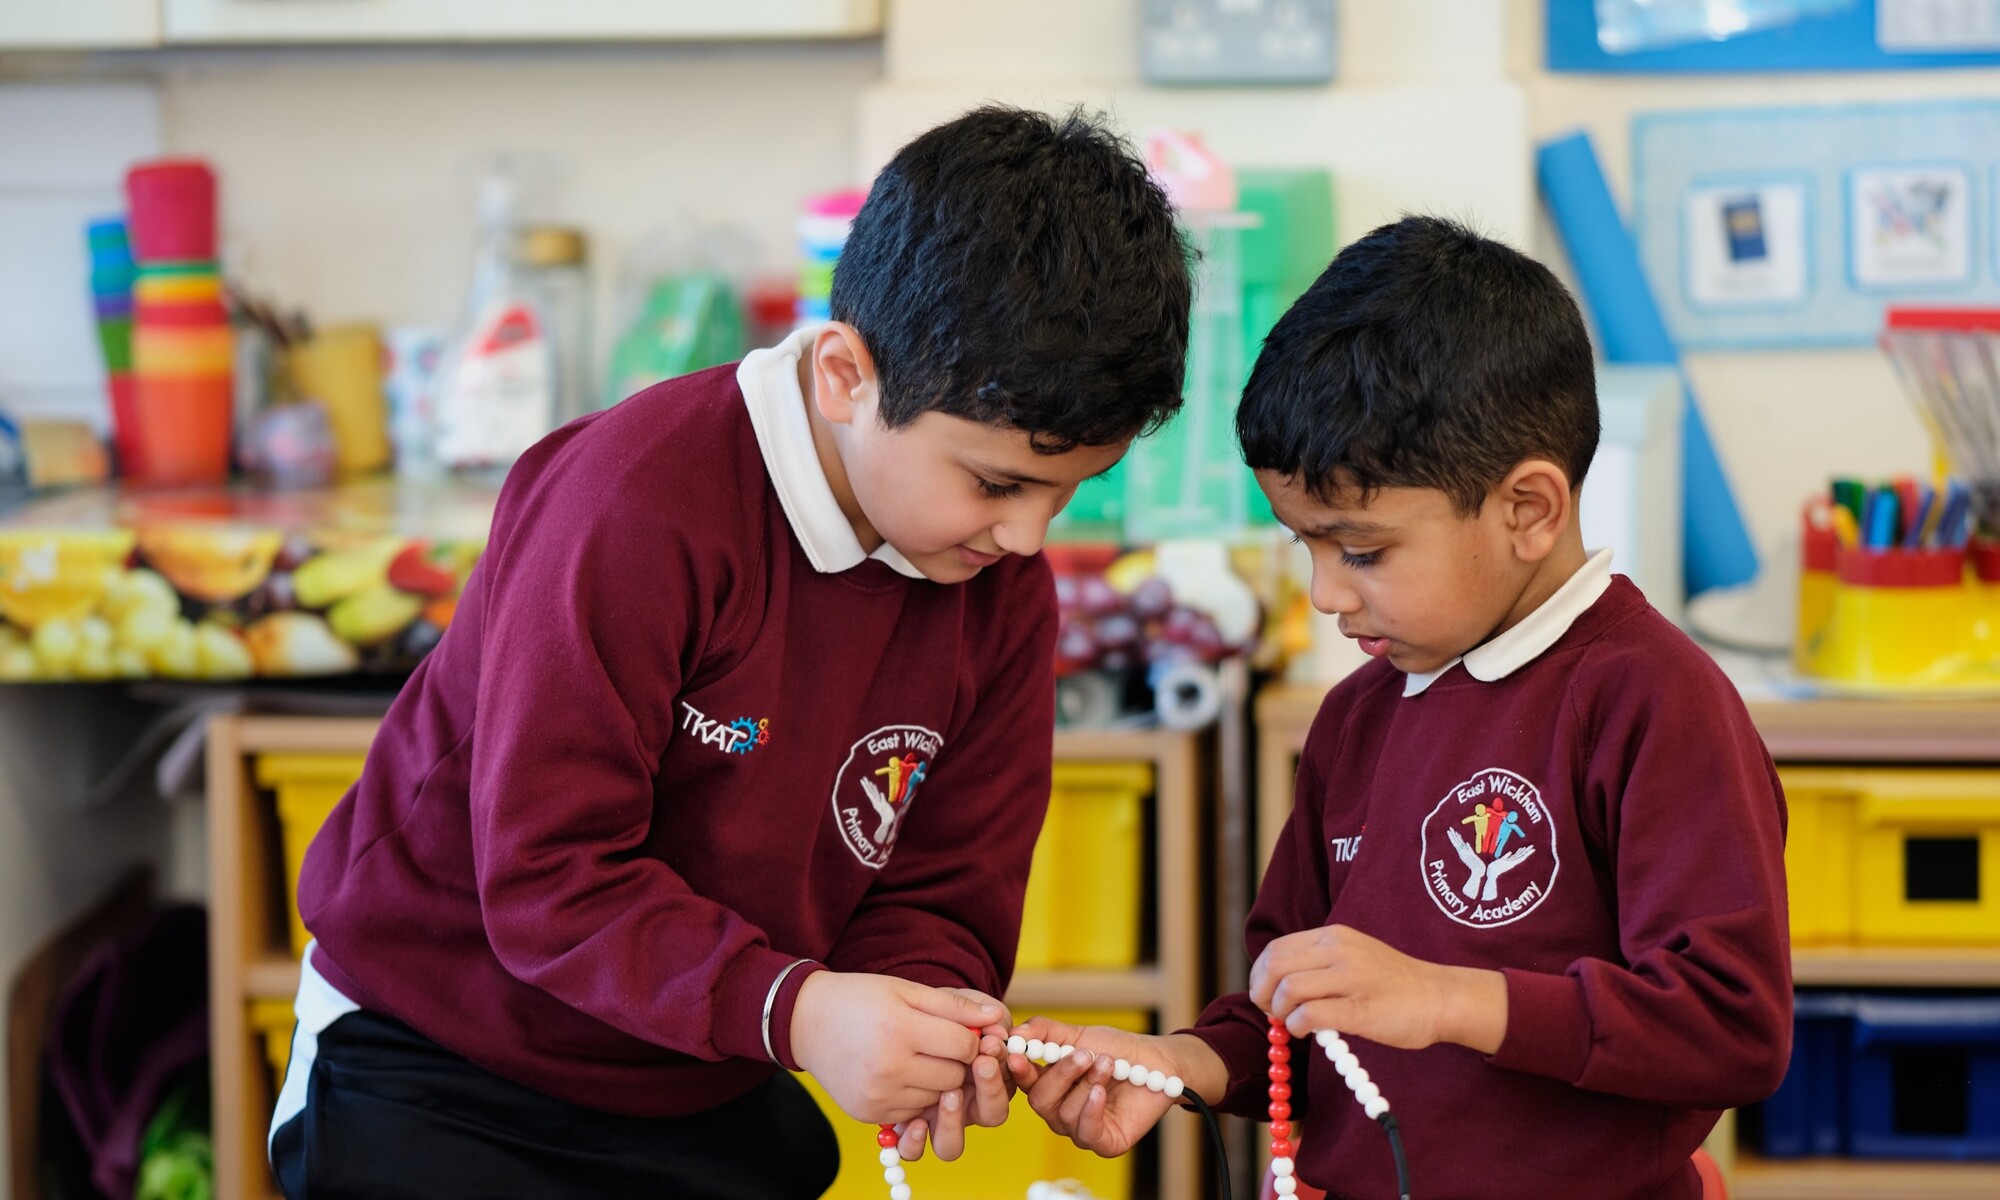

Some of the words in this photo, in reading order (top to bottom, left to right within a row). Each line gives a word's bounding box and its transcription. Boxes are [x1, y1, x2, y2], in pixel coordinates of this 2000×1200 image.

[681, 700, 748, 753] TKAT
[867, 732, 900, 755] East
[1457, 779, 1485, 804] East
[1488, 774, 1542, 824] Wickham
[842, 807, 878, 861] Primary
[1331, 835, 1363, 862] TKA
[1429, 859, 1469, 916] Primary
[1469, 880, 1542, 922] Academy
